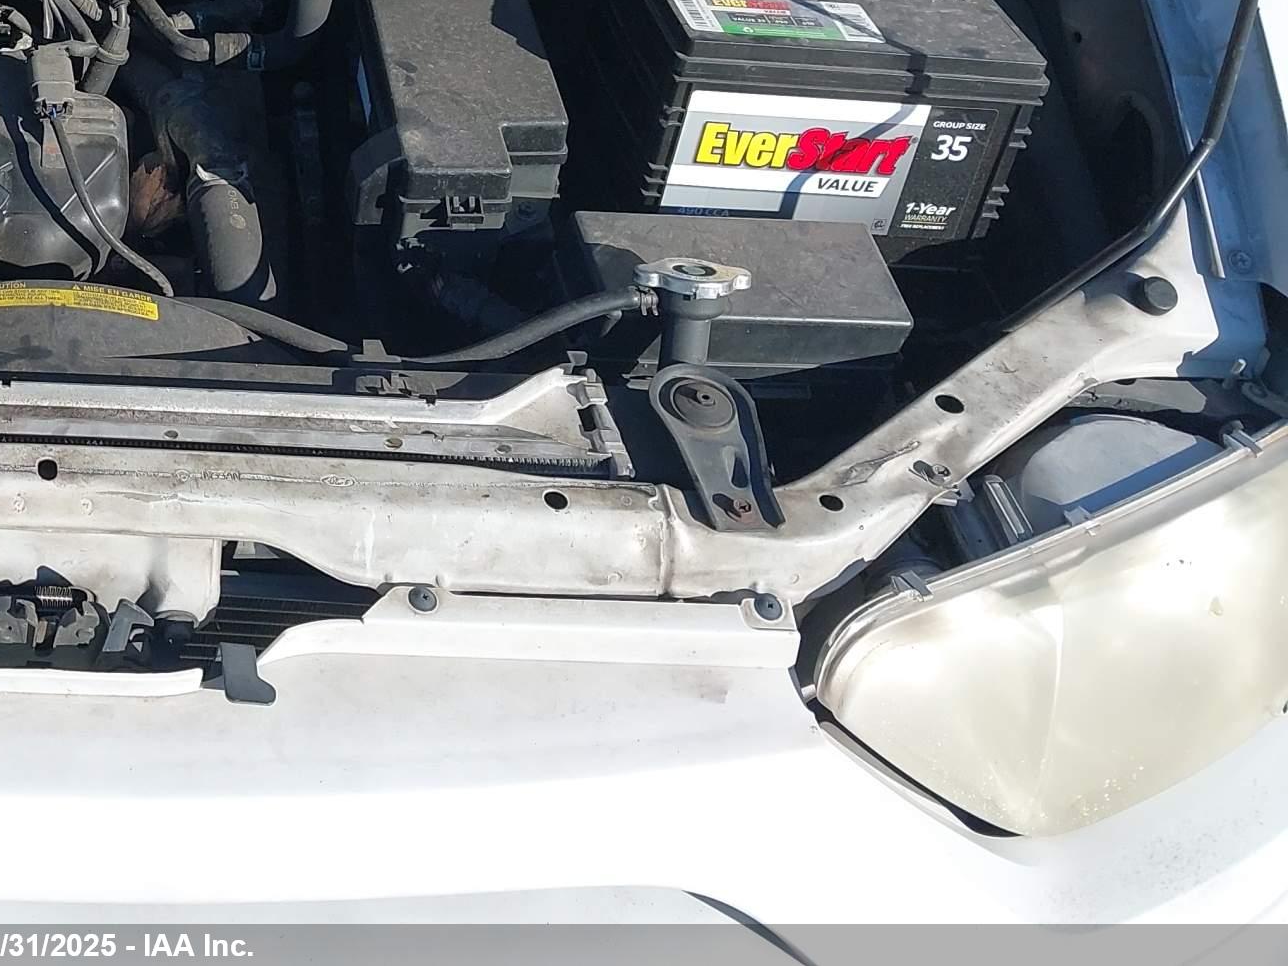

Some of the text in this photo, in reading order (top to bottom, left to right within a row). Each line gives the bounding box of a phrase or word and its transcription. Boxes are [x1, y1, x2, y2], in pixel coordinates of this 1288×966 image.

[933, 121, 986, 130] GROUP SIZE
[694, 120, 912, 175] EverStart
[931, 134, 972, 161] 35
[817, 177, 879, 193] VALUE
[905, 202, 956, 215] 1-Year
[904, 214, 948, 222] WARRANTY
[83, 285, 105, 293] MISE
[107, 288, 119, 296] EN
